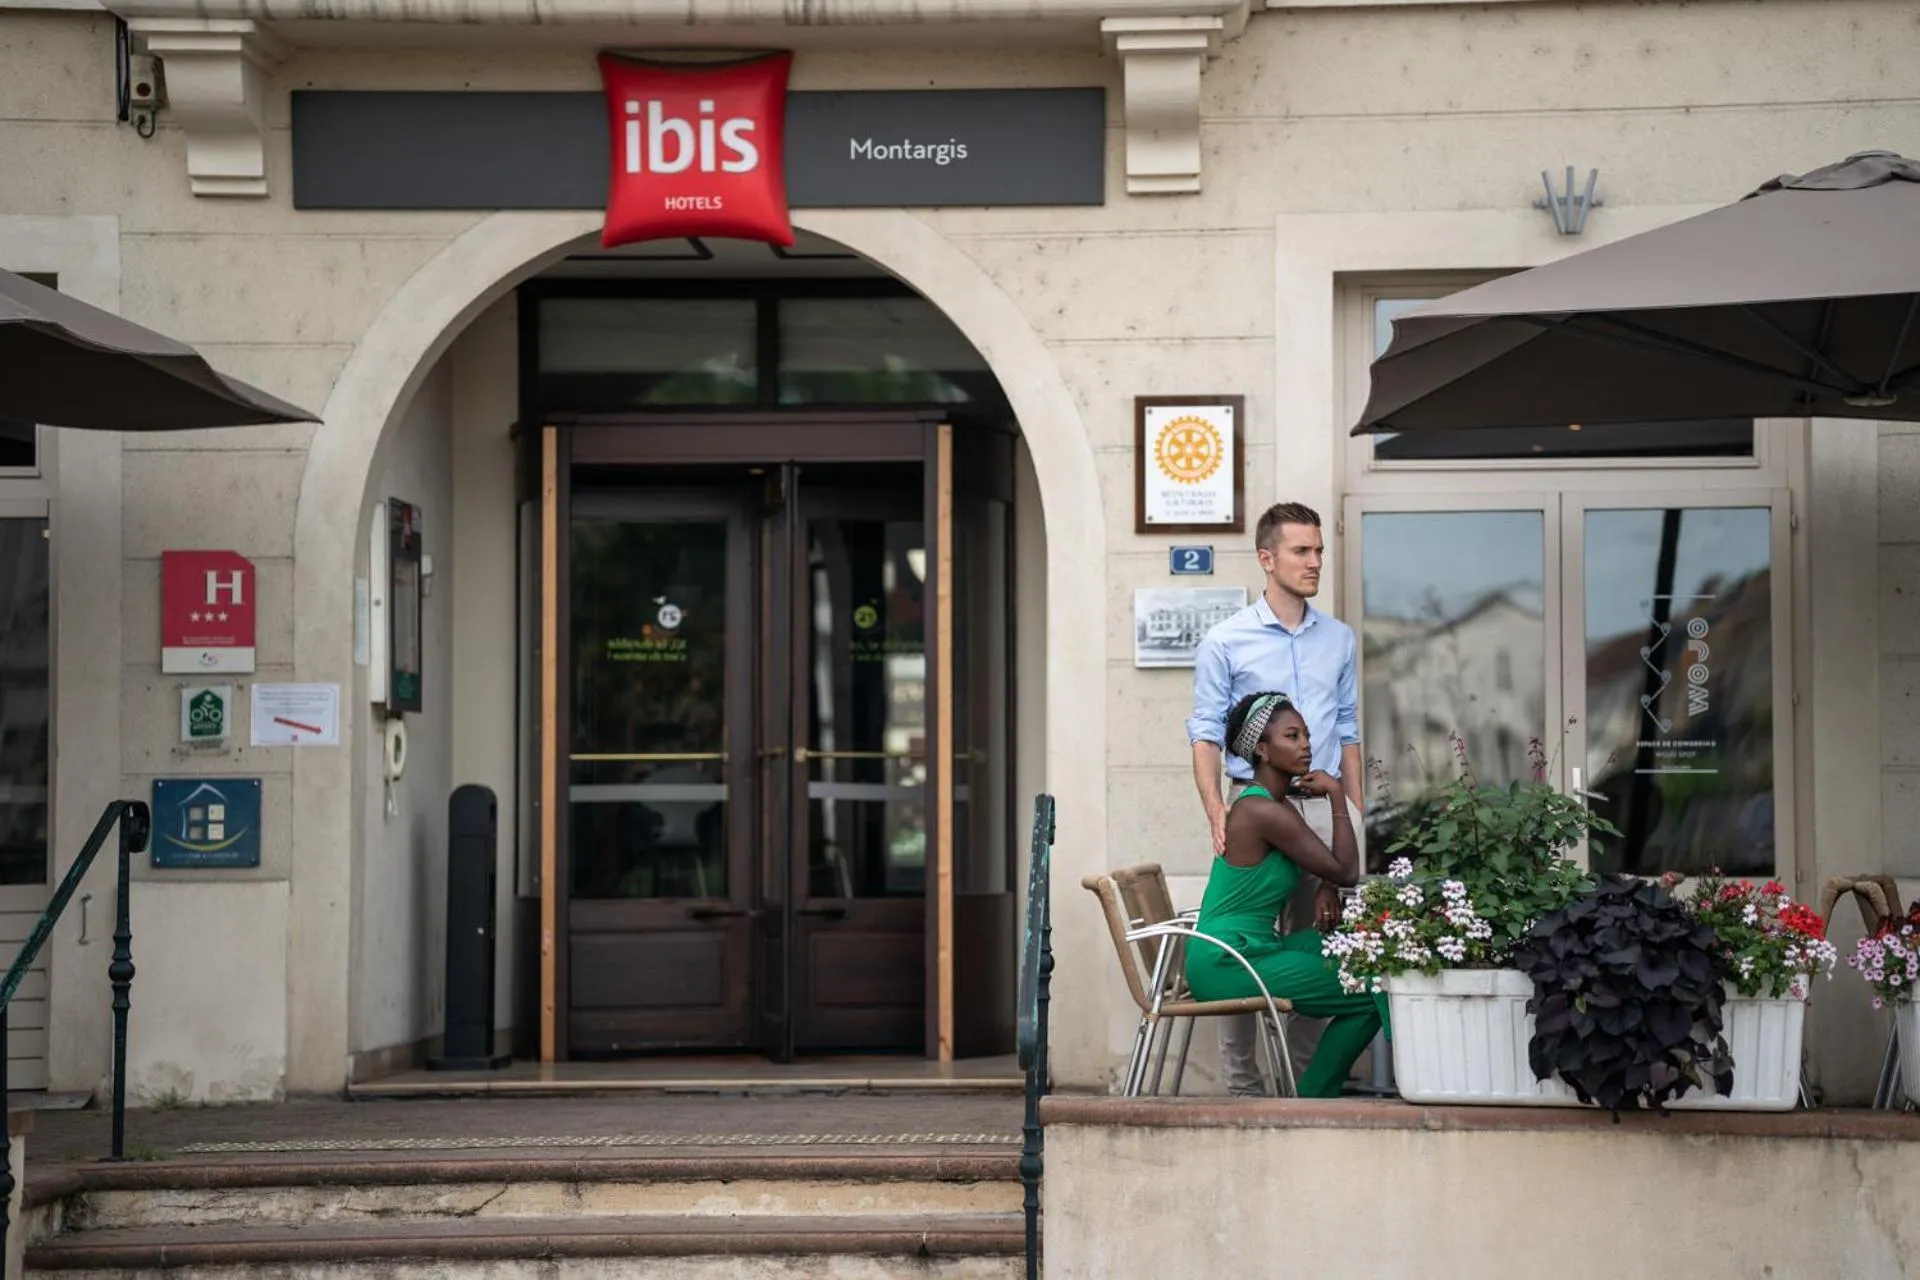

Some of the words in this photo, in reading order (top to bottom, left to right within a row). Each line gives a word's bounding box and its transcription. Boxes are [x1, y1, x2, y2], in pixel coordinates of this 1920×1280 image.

[625, 100, 759, 174] ibis
[850, 138, 968, 165] Montargis
[665, 197, 722, 210] HOTELS
[1184, 551, 1200, 570] 2
[203, 569, 245, 605] H
